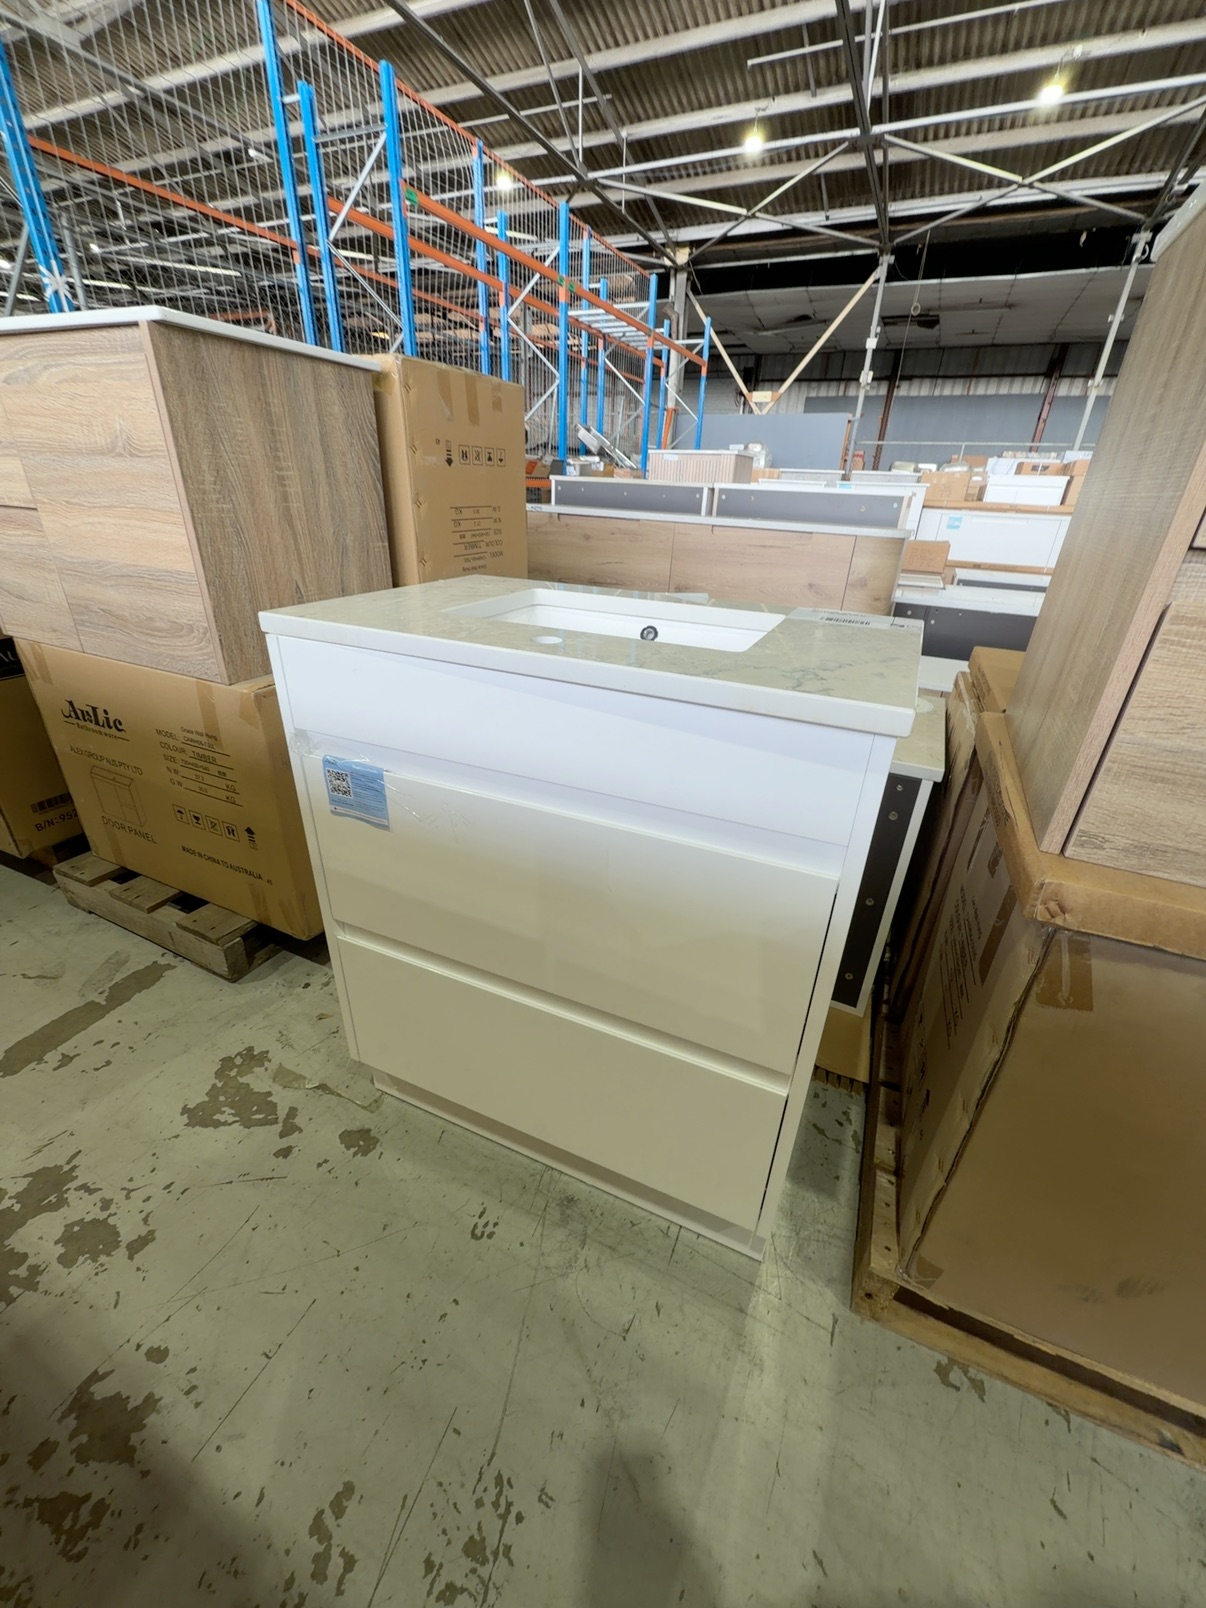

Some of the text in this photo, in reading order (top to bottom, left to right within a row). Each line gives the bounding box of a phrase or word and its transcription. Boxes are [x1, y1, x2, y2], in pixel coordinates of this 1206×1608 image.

[191, 750, 217, 764] TIMBER
[225, 783, 237, 792] KG
[225, 795, 237, 805] KG
[101, 815, 158, 844] DOOR PANEL
[229, 863, 264, 880] AUSTRALIA
